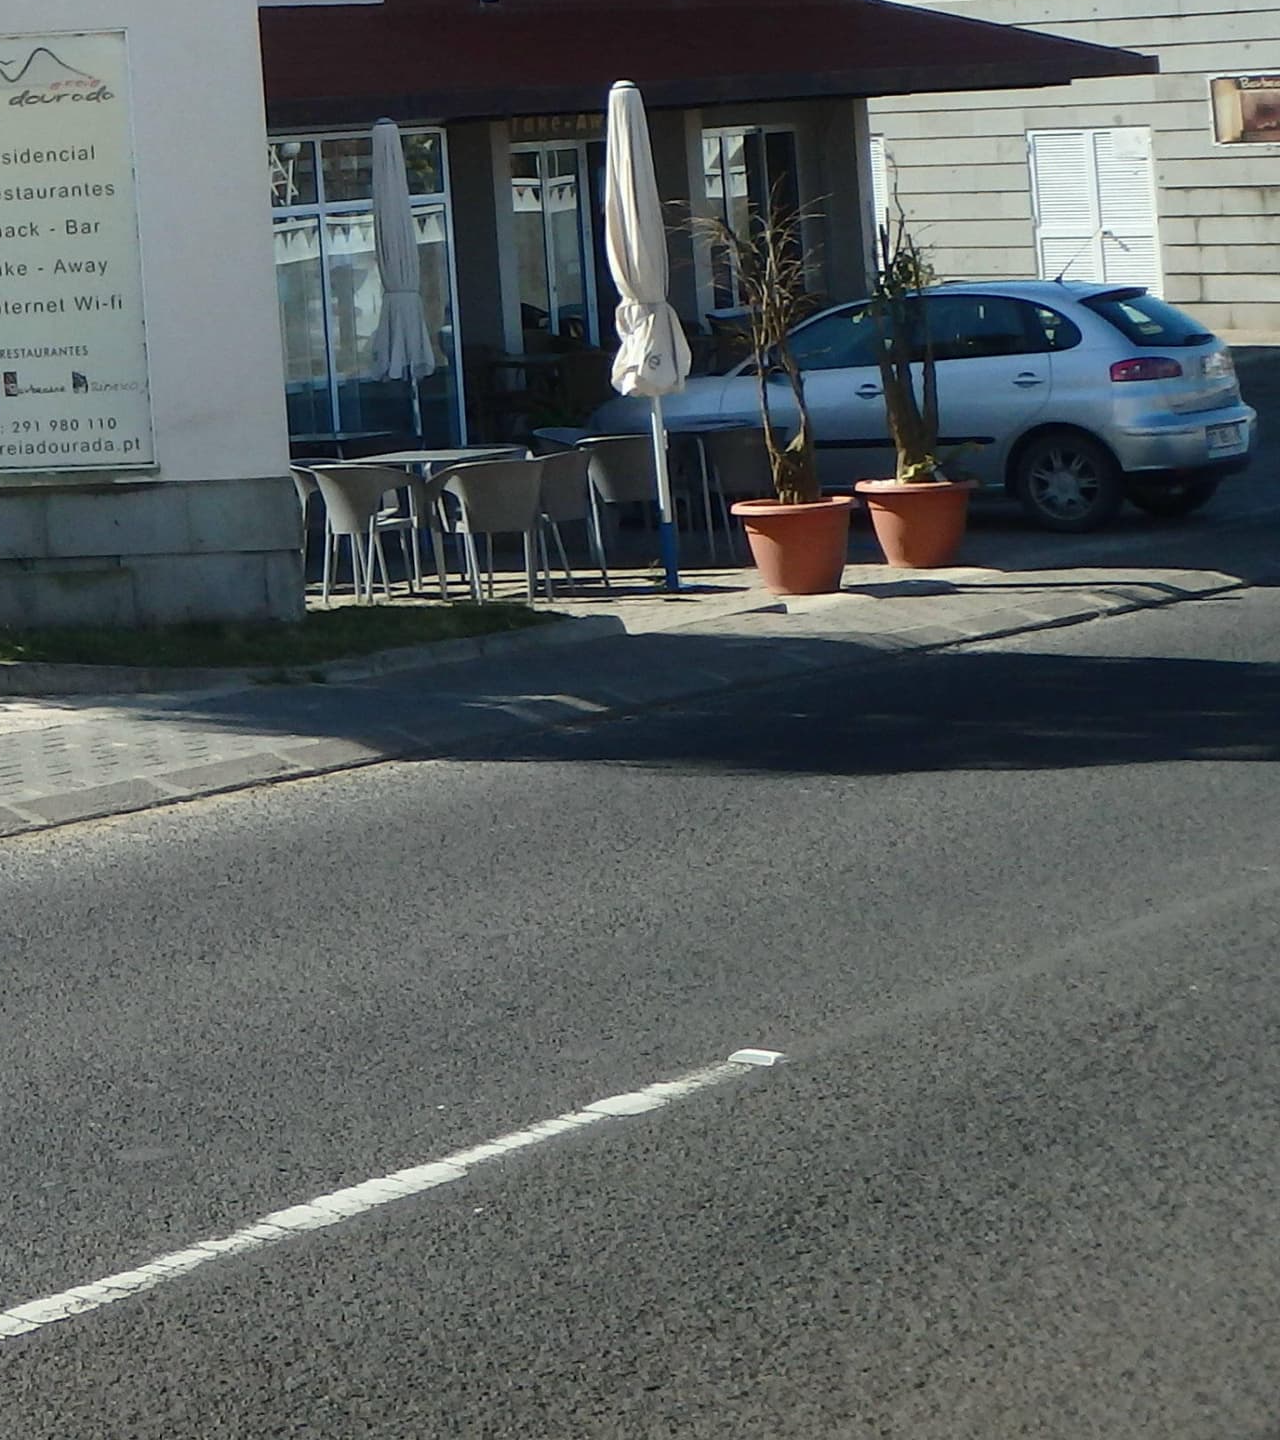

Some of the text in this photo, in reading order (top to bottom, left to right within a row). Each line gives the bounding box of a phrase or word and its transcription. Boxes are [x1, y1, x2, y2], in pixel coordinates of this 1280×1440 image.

[8, 85, 115, 107] dourada
[65, 219, 100, 235] Bar
[53, 259, 108, 276] Away
[74, 294, 122, 311] Wi-fi
[0, 345, 88, 359] RESTAURANTES
[12, 421, 40, 434] 291
[49, 419, 79, 432] 980
[89, 417, 117, 430] 110
